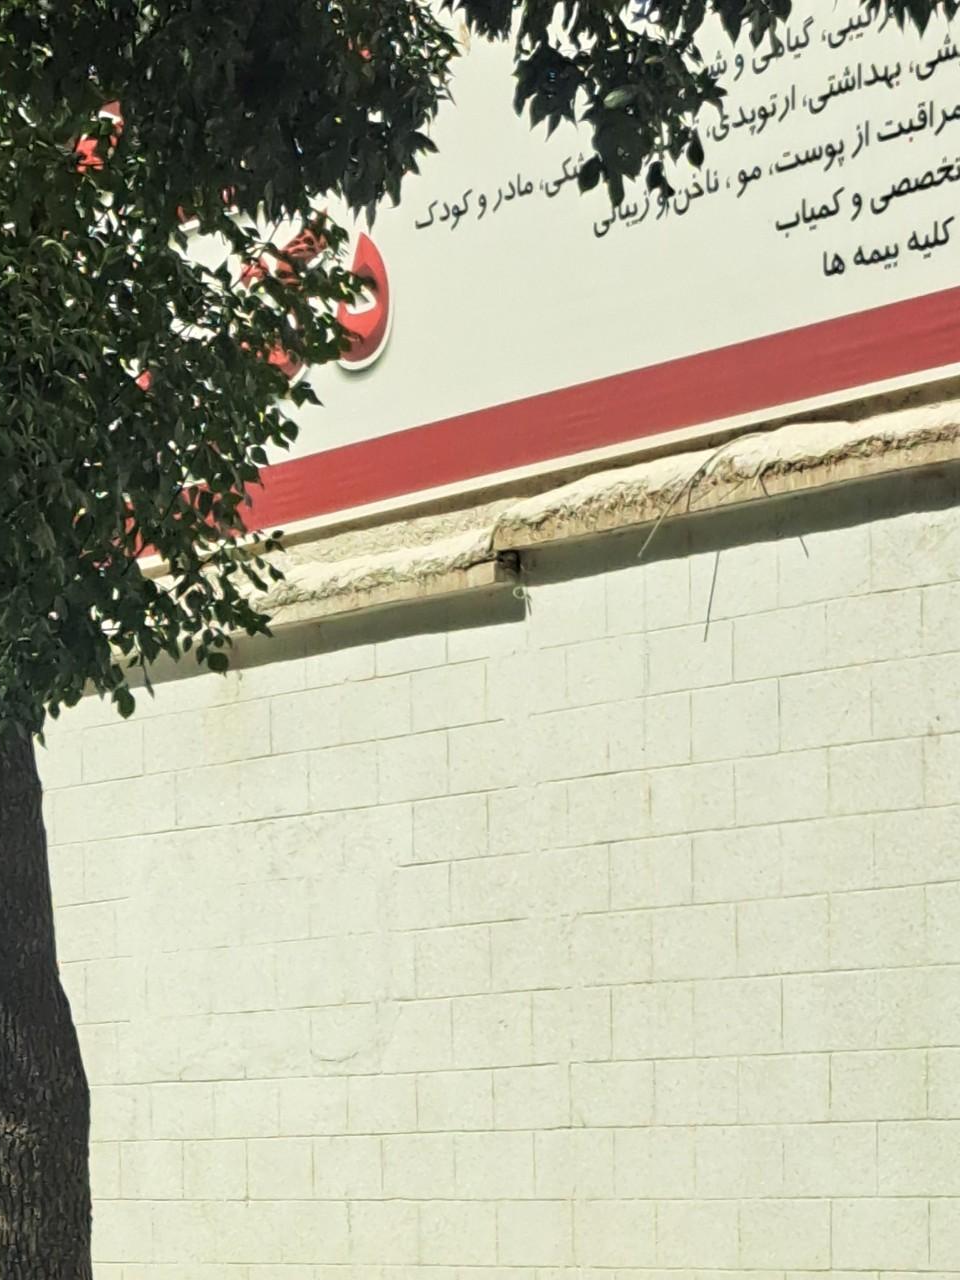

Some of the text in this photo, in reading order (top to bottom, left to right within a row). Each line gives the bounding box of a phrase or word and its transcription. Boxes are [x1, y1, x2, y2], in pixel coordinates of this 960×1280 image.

[734, 53, 744, 81] و
[851, 120, 869, 158] از
[876, 100, 960, 143] مراقبت
[769, 138, 844, 176] پوست،
[415, 189, 473, 230] کودک
[477, 195, 487, 220] و
[492, 173, 534, 213] مادر
[673, 168, 719, 216] ناخن
[851, 193, 863, 221] و
[775, 187, 844, 238] کمیاب
[822, 216, 955, 277] کلیه بیمه ها
